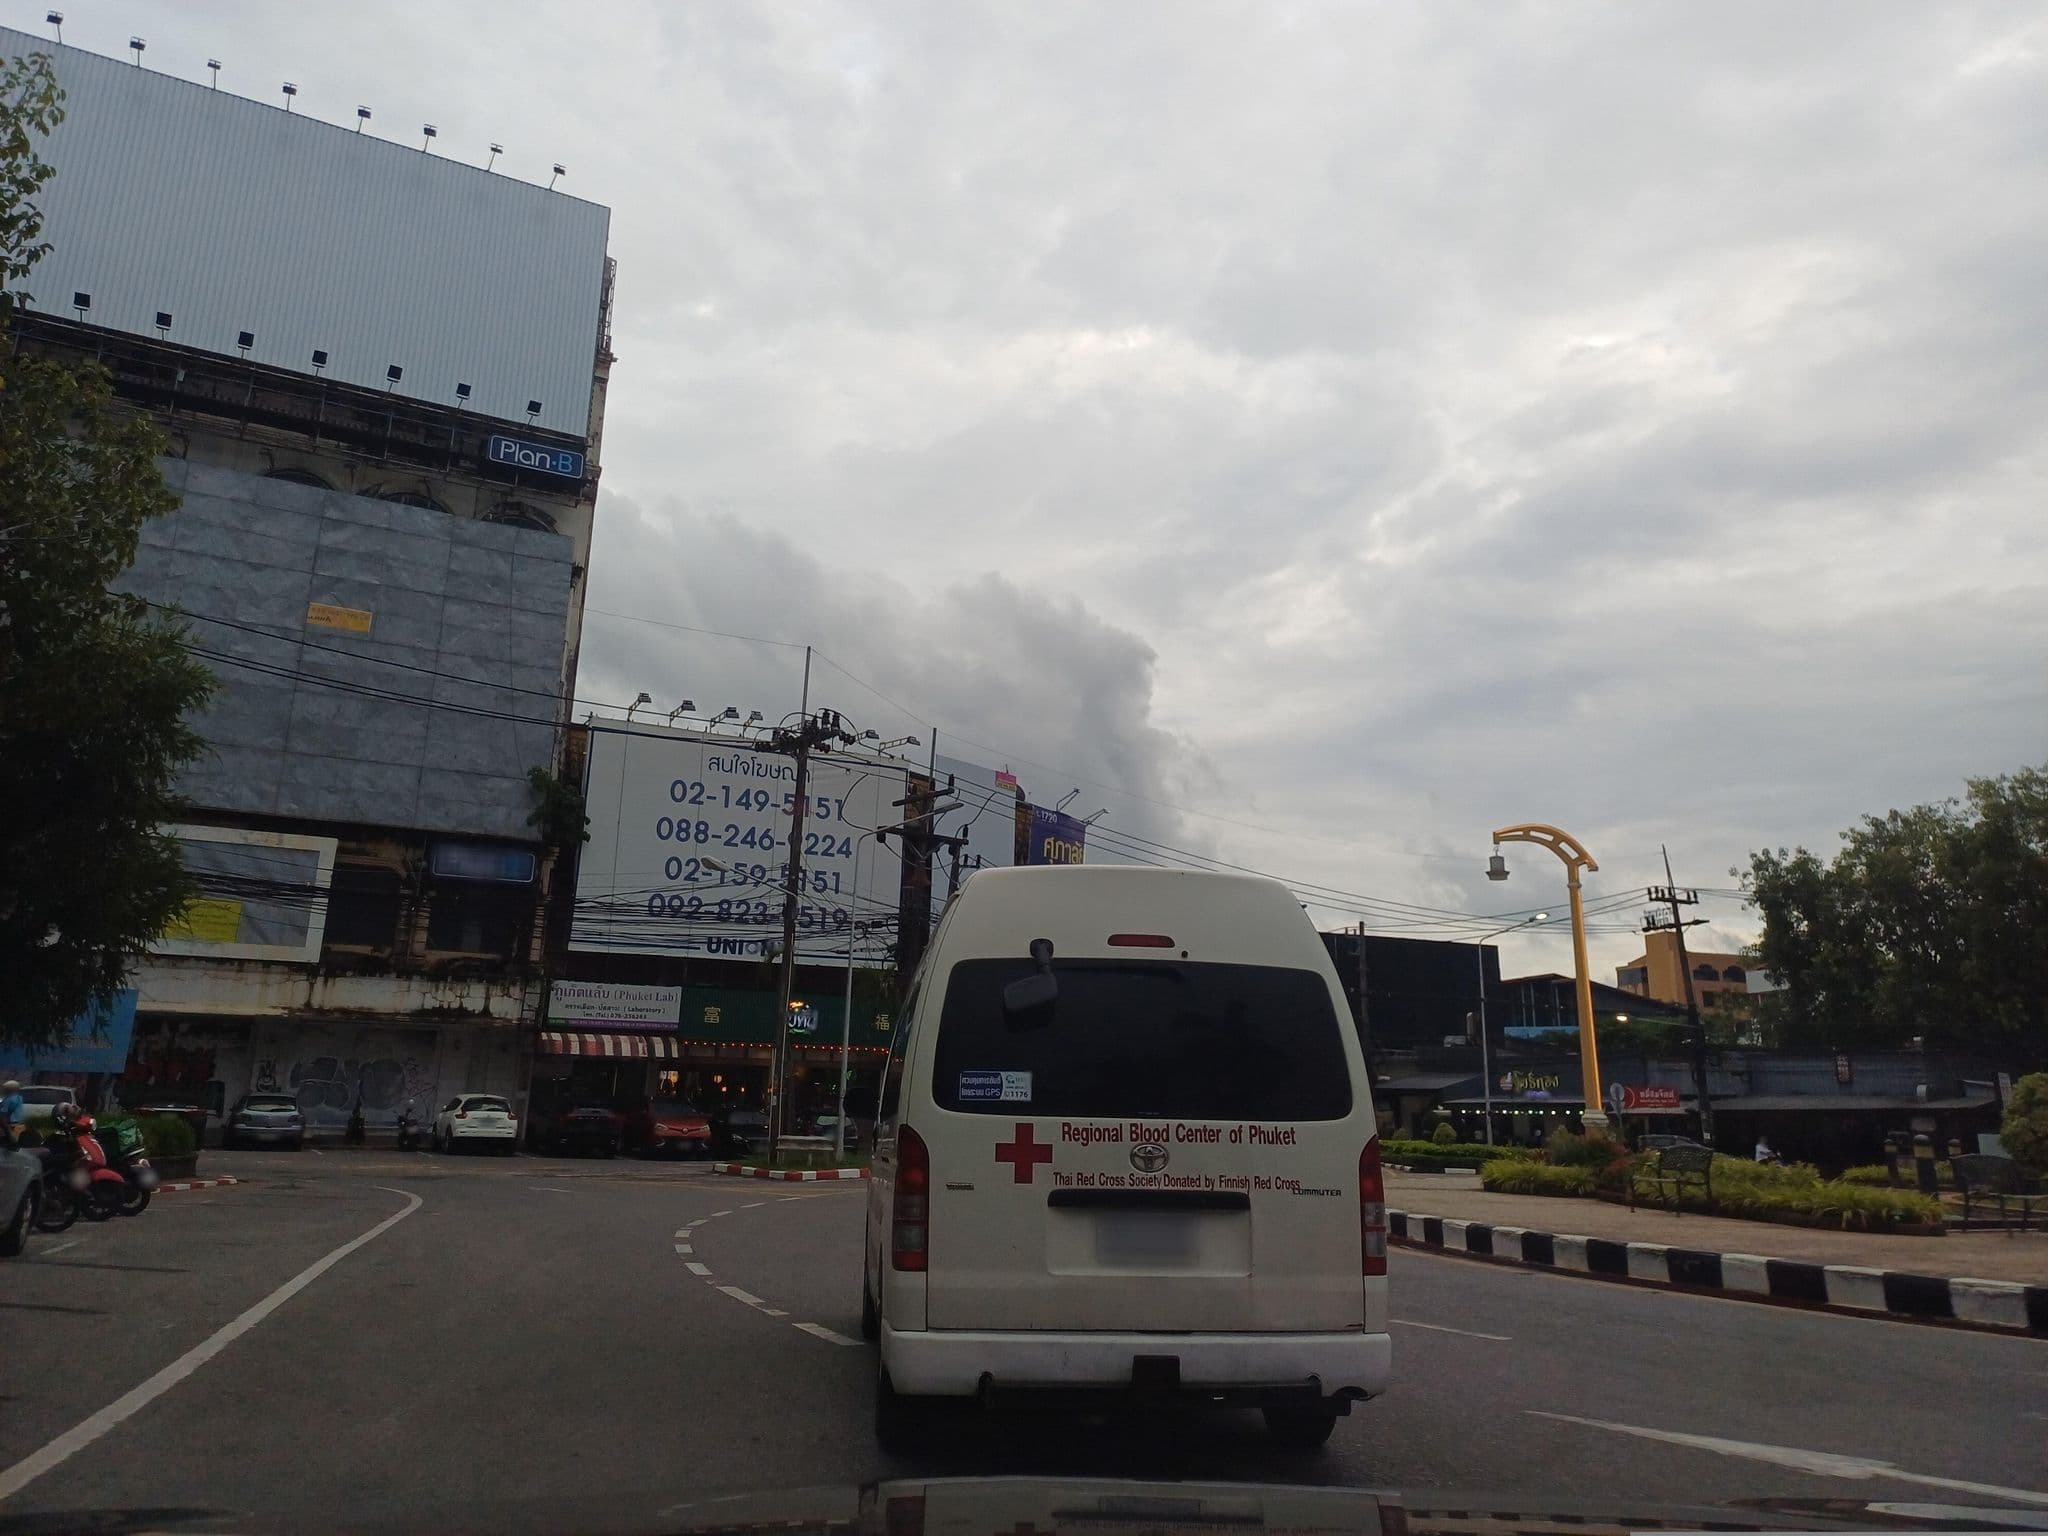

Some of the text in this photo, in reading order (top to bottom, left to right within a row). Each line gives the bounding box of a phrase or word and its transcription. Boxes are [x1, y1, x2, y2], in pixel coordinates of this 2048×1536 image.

[670, 779, 843, 821] 02-149-5151
[648, 893, 849, 929] 092-823-519
[875, 1014, 890, 1031] 福
[985, 1088, 1001, 1097] GPS
[1062, 1122, 1297, 1146] Regional Blood Center of Phuket
[1053, 1172, 1301, 1191] Thai Red Cross Society Donated by Finnish Red Cross
